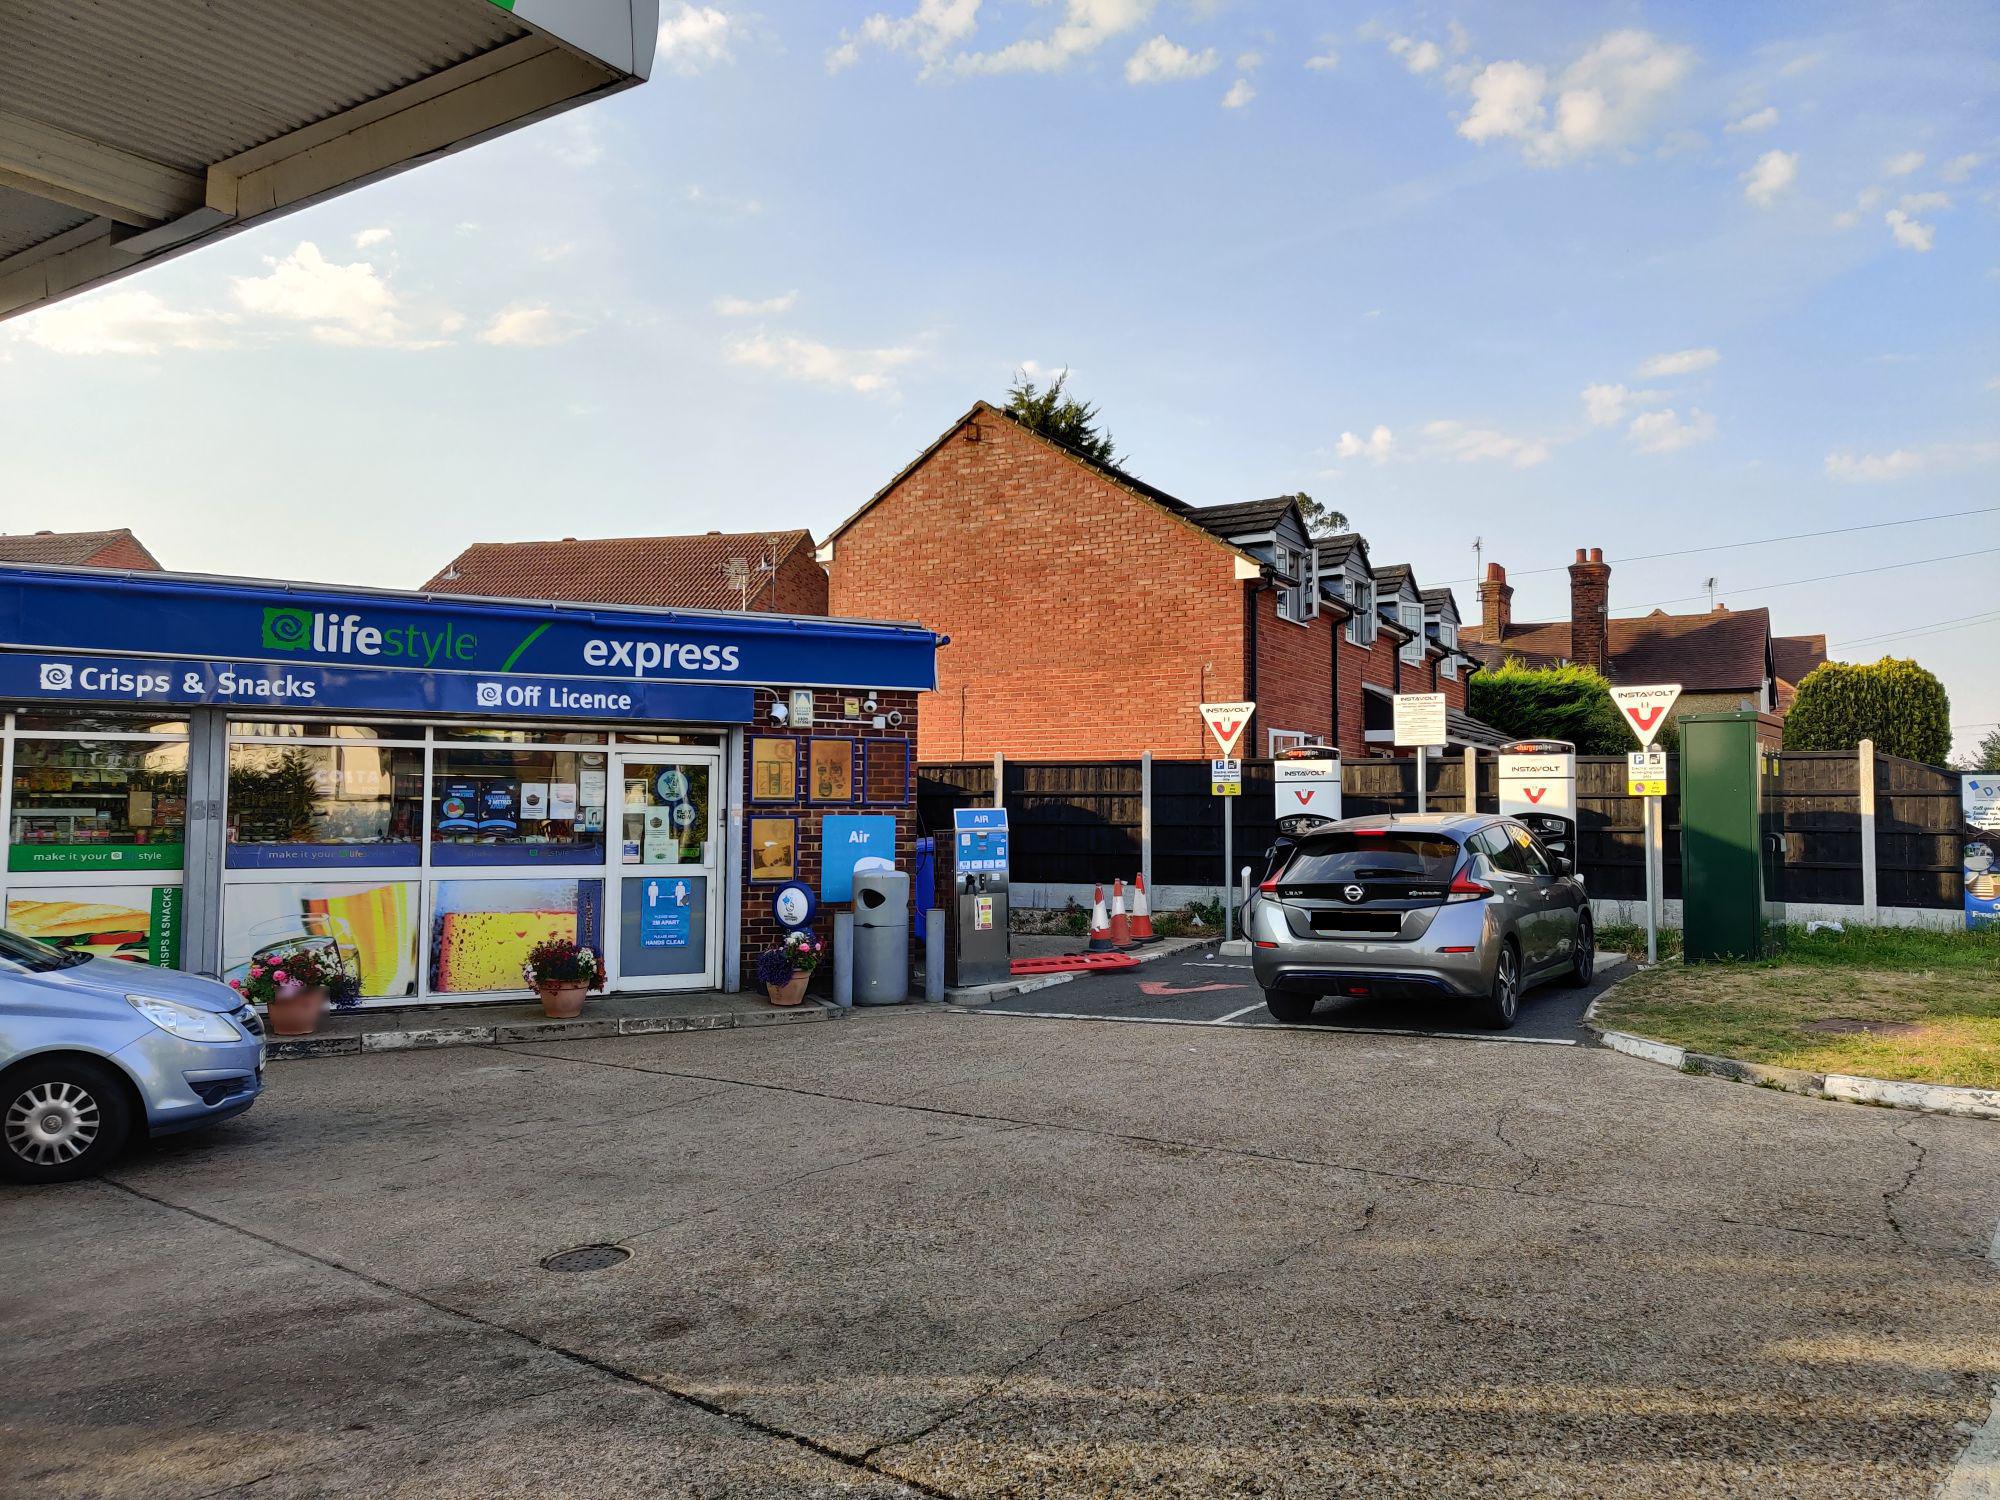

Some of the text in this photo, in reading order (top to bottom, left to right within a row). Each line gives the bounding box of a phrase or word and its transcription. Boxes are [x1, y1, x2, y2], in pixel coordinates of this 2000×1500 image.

[313, 612, 477, 668] lifestyle
[583, 636, 740, 676] express
[79, 667, 316, 698] Crisps & Snacks
[1618, 690, 1676, 698] INSTAVOLT
[506, 684, 632, 710] Off Licence
[974, 815, 989, 824] AIR
[848, 830, 871, 843] Air
[33, 850, 162, 863] make it your style
[268, 850, 298, 859] make
[301, 849, 308, 859] it
[162, 888, 173, 929] SNACKS
[160, 939, 170, 969] RISPS
